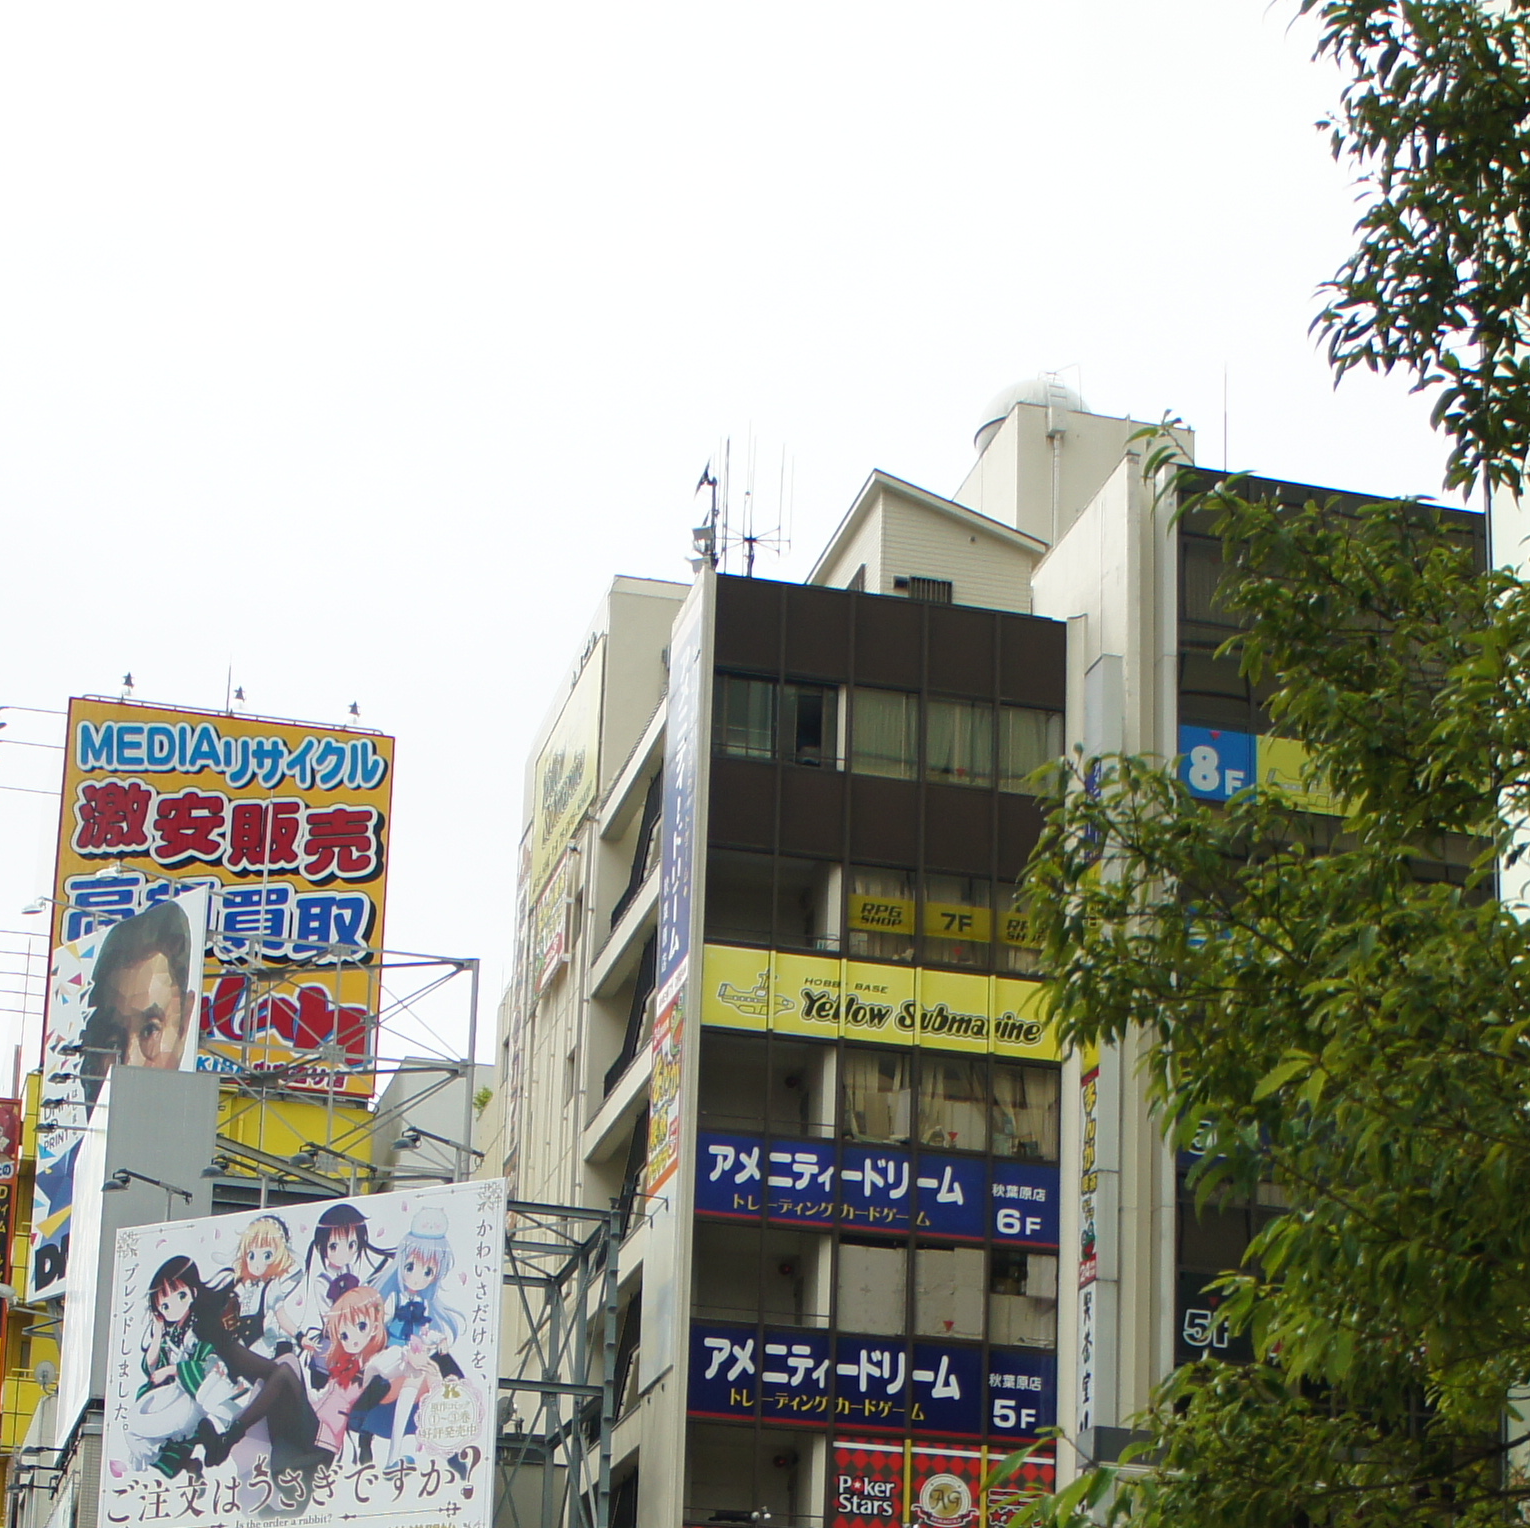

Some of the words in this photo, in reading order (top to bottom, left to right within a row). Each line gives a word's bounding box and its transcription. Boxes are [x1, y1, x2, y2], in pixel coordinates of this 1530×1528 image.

[78, 723, 385, 788] MEDIAリサイクル
[1189, 745, 1244, 797] 8F
[75, 781, 375, 876] 激安販売
[67, 876, 367, 958] 高買取
[860, 914, 902, 928] SHOP
[861, 902, 903, 919] RPG
[941, 912, 973, 933] 7F
[854, 981, 889, 995] BASE
[707, 1144, 964, 1206] アメニティードリーム
[991, 1181, 1047, 1203] 秋葉原店
[996, 1207, 1043, 1236] 6F
[469, 1217, 492, 1382] かわいさだけを、
[702, 1337, 960, 1400] アメニティードリーム
[988, 1371, 1043, 1393] 秋葉原店
[992, 1400, 1038, 1430] 5F
[106, 1444, 480, 1523] ご注文はうさぎですか?
[837, 1494, 894, 1516] Stars
[262, 1516, 287, 1528] order
[298, 1513, 333, 1527] rabbit?
